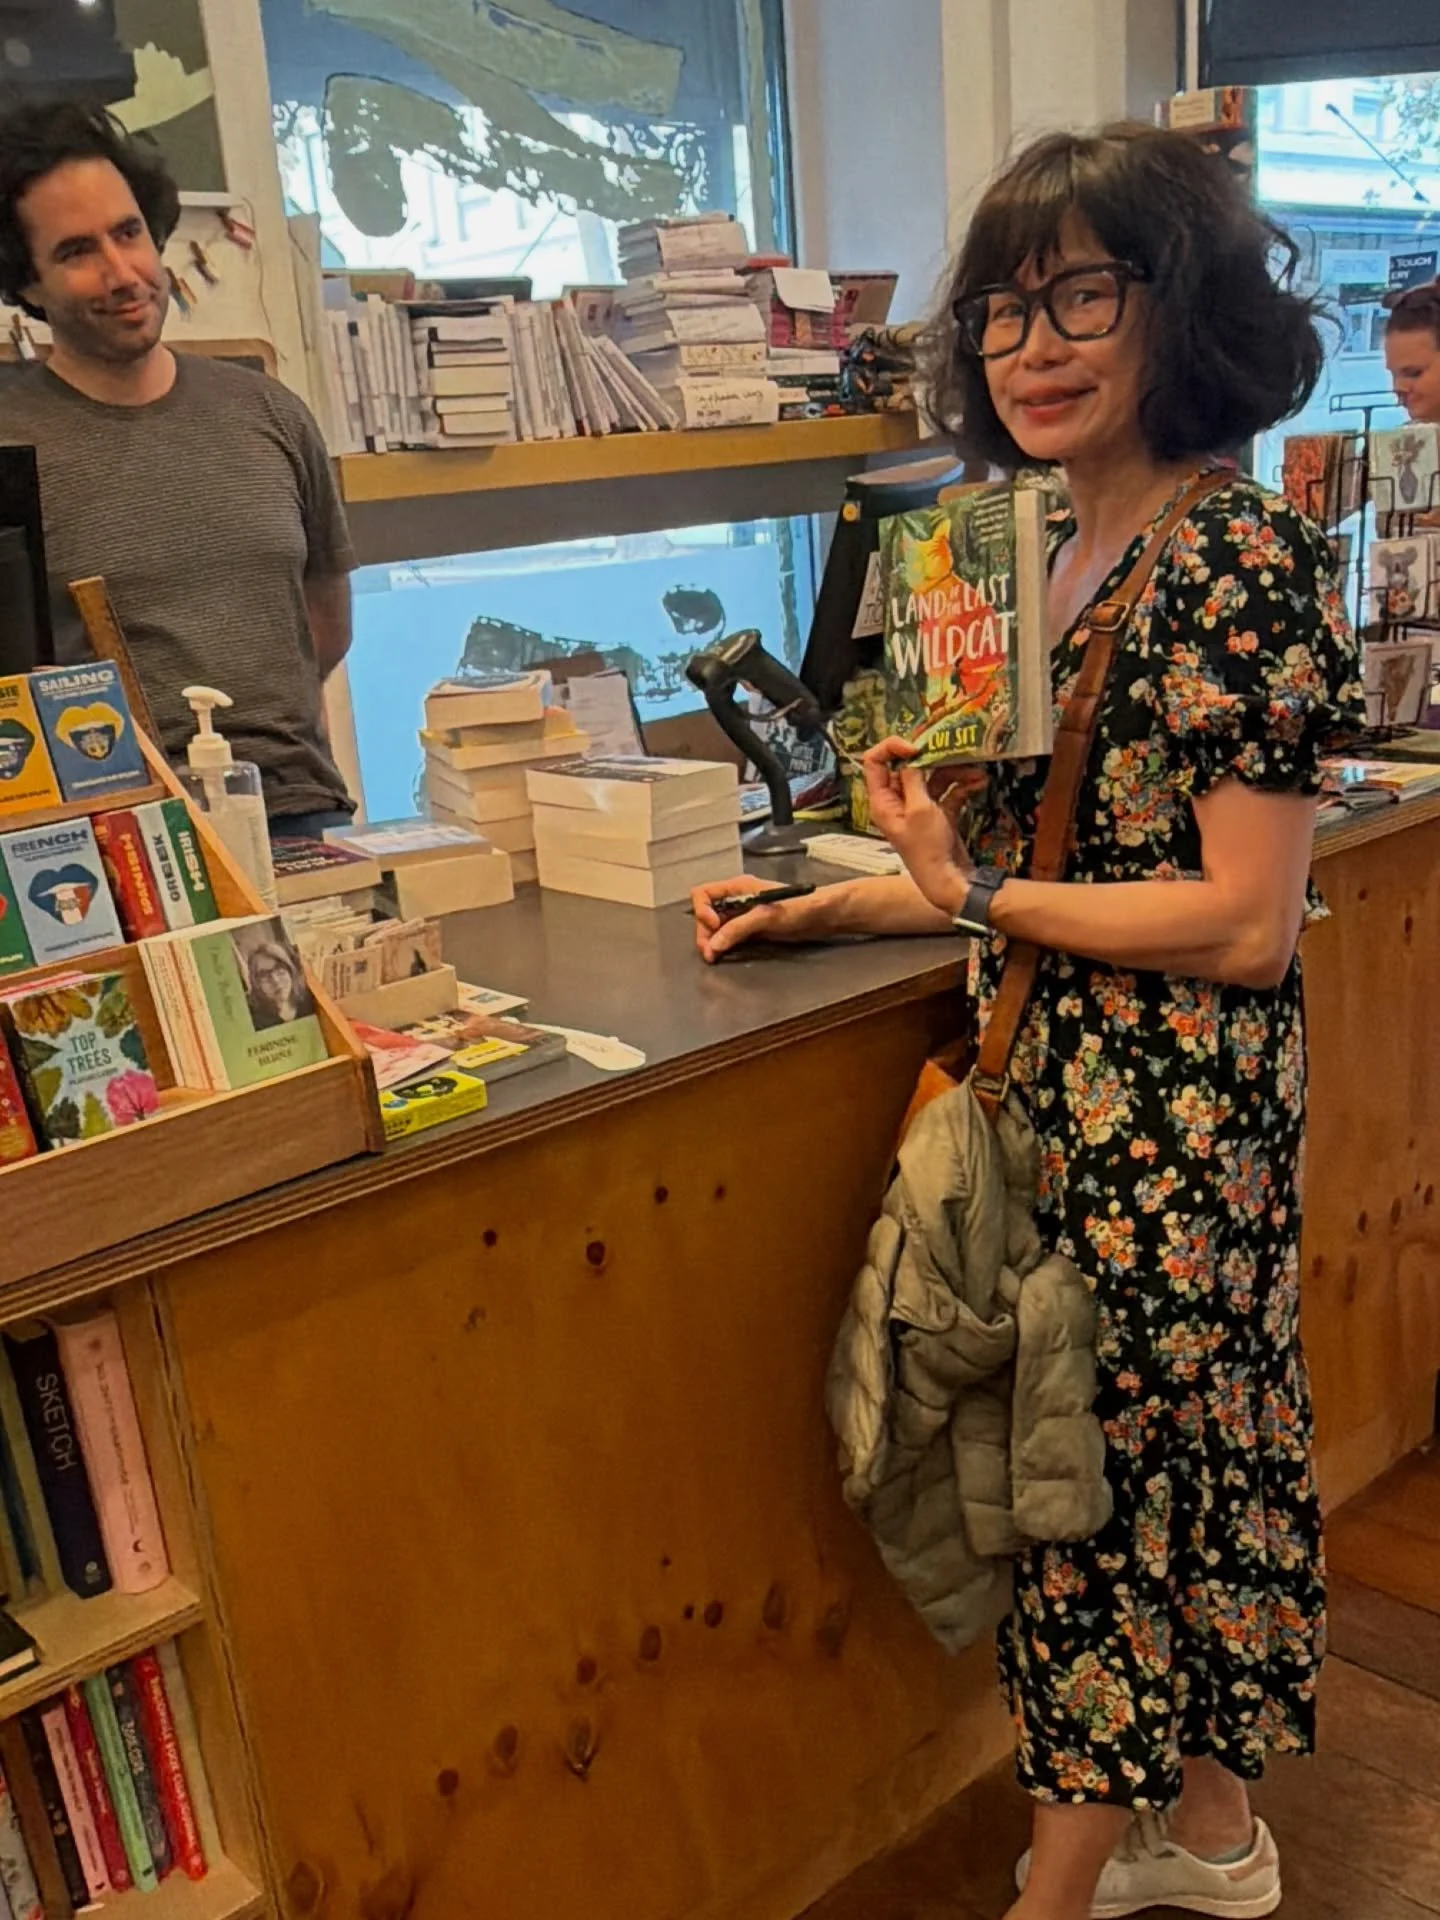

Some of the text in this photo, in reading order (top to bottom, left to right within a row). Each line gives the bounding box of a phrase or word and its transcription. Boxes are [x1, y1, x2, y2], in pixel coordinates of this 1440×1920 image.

[891, 590, 947, 628] LAND
[963, 573, 1010, 612] LAST
[891, 611, 1017, 680] WILDCAT
[38, 669, 115, 692] SAILING
[11, 829, 89, 853] FRENCH
[152, 832, 182, 903] GREEK
[177, 830, 206, 893] IRISH
[65, 1047, 113, 1075] TREES
[69, 1031, 97, 1053] TOP
[35, 1373, 78, 1472] SKETCH
